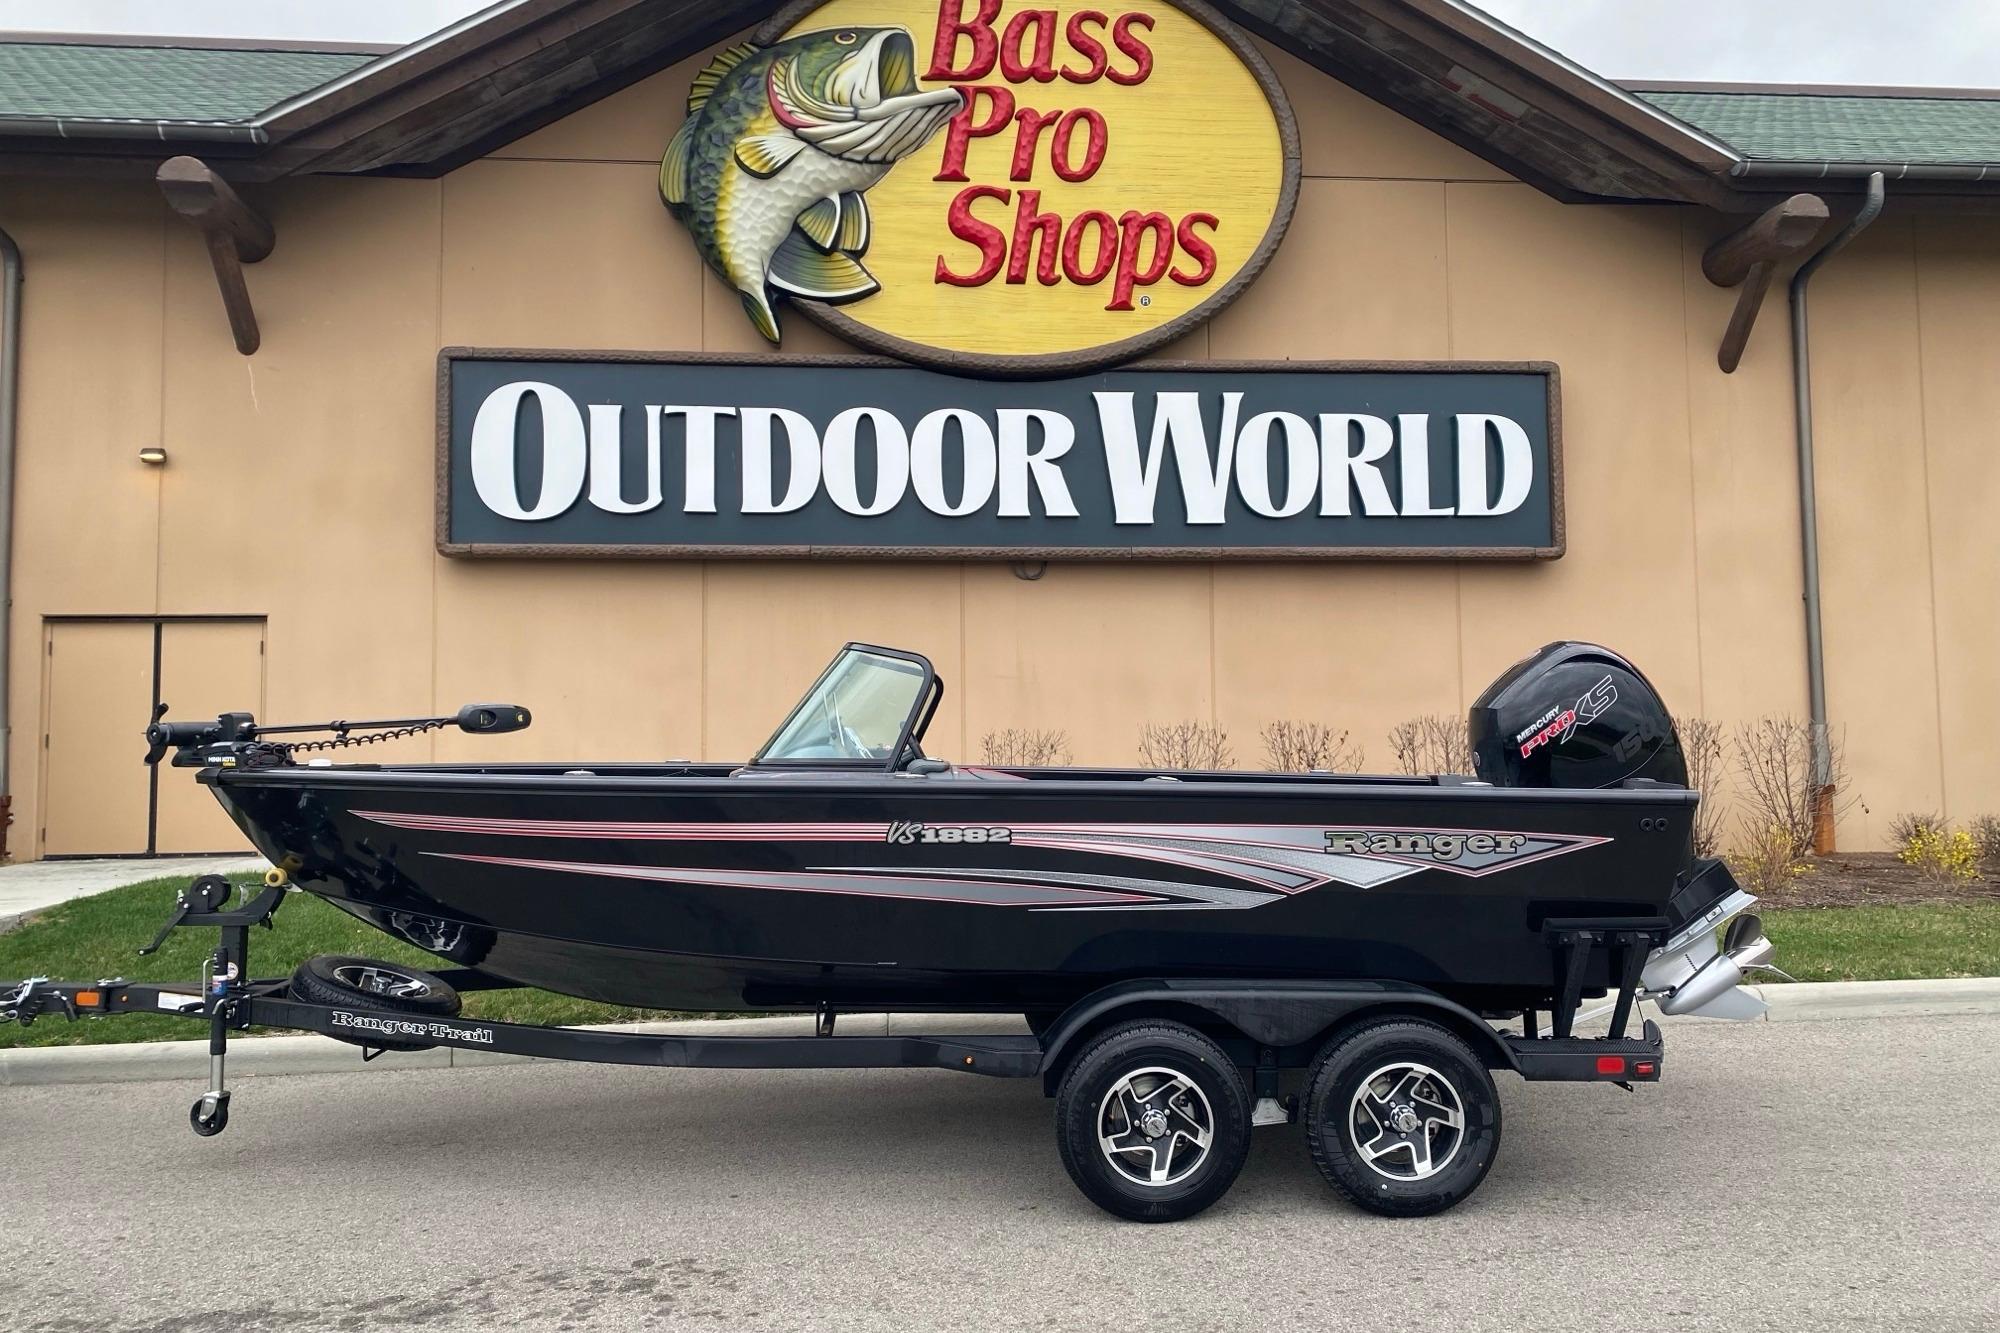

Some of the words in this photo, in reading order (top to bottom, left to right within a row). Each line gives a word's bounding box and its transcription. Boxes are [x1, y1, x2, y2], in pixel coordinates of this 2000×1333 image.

[920, 0, 1156, 86] Bass
[932, 85, 1109, 183] Pro
[934, 185, 1220, 311] Shops
[470, 381, 1080, 521] OUTDOOR
[1091, 391, 1534, 524] WORLD
[1516, 705, 1560, 743] MERCURY
[1324, 831, 1528, 862] Ranger
[332, 1010, 428, 1035] Ranger
[428, 1022, 494, 1044] Trail
